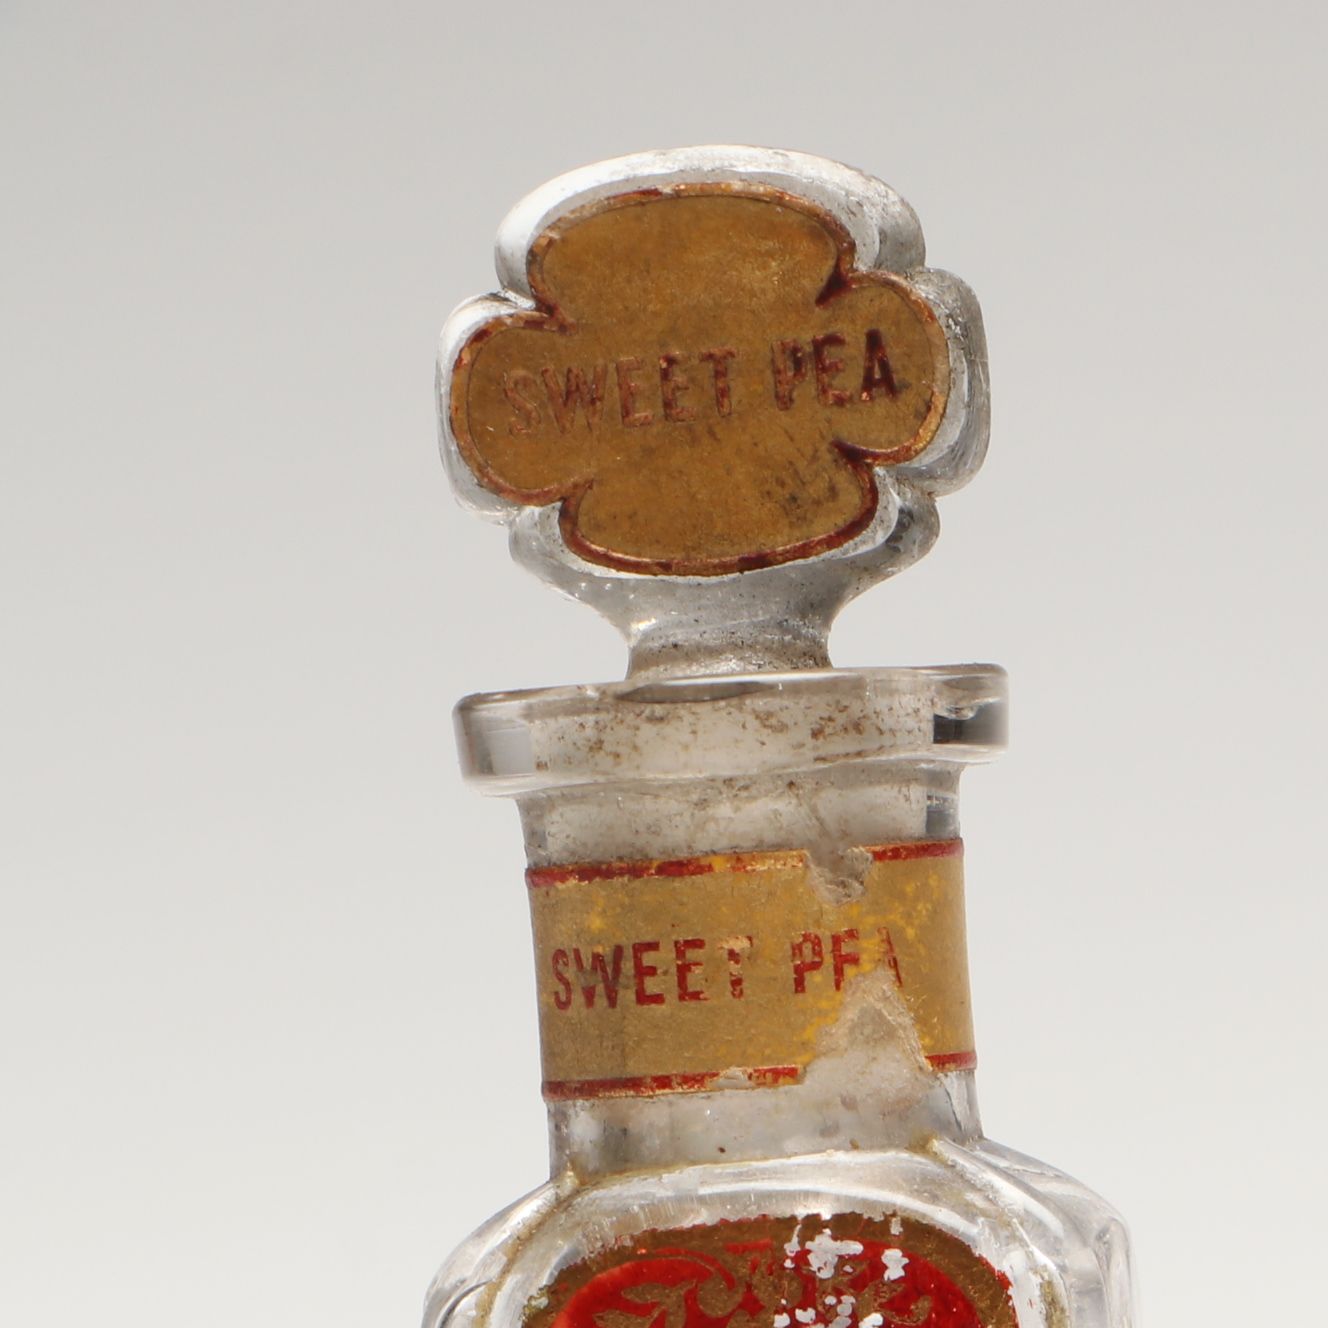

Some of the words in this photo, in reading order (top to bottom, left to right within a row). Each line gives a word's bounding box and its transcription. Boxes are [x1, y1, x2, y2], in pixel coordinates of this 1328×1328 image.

[502, 346, 737, 436] SWEET
[771, 328, 900, 413] PEA
[551, 935, 755, 1012] SWEET
